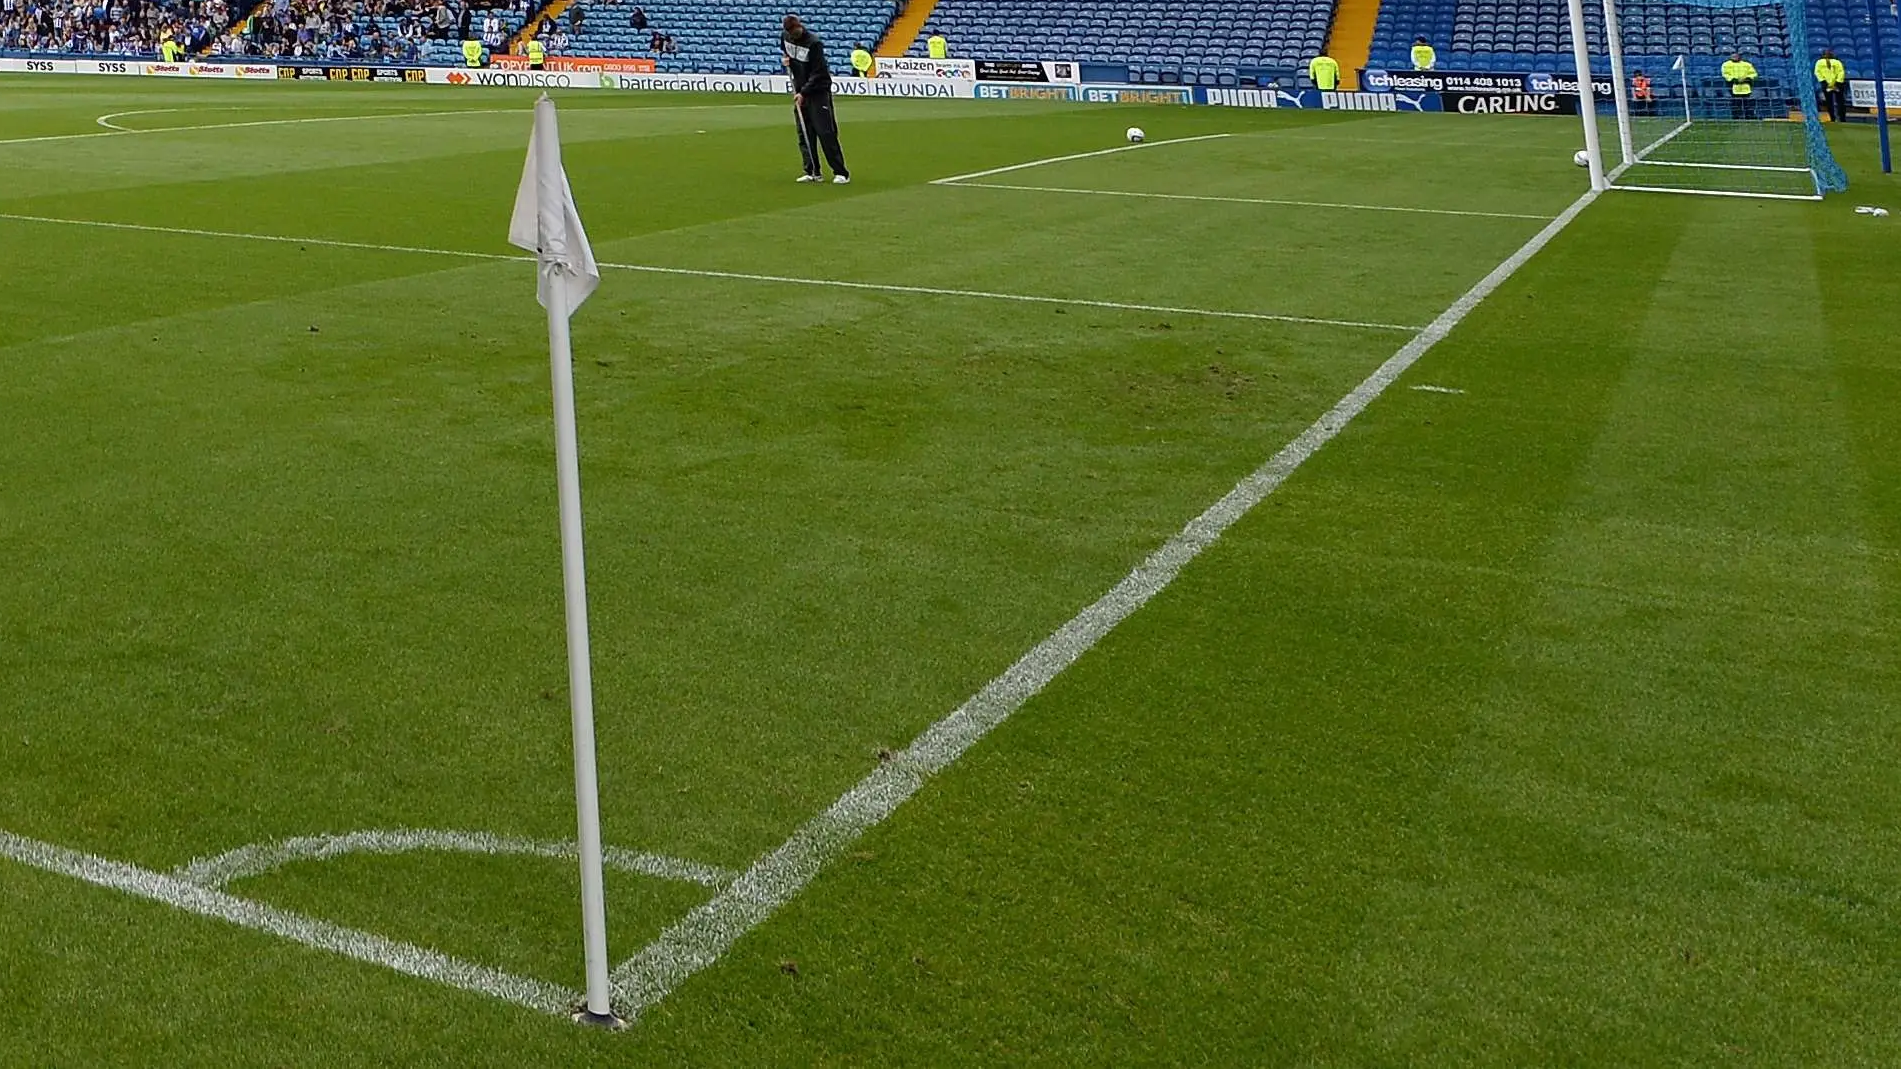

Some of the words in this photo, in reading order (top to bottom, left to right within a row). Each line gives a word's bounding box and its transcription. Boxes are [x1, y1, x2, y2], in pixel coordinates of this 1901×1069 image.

[26, 61, 54, 71] SYSS
[98, 62, 126, 73] SYSS
[895, 59, 935, 71] kaizen
[619, 75, 762, 93] bartercard.co.uk
[875, 83, 955, 97] HYUNDAI
[1368, 74, 1443, 91] tchleasing
[1446, 77, 1471, 85] 0114
[1495, 78, 1522, 87] 1013
[1530, 78, 1612, 95] tchleang
[1206, 88, 1278, 108] PUMA
[1321, 91, 1397, 111] PUMA
[1458, 94, 1557, 114] CARLING
